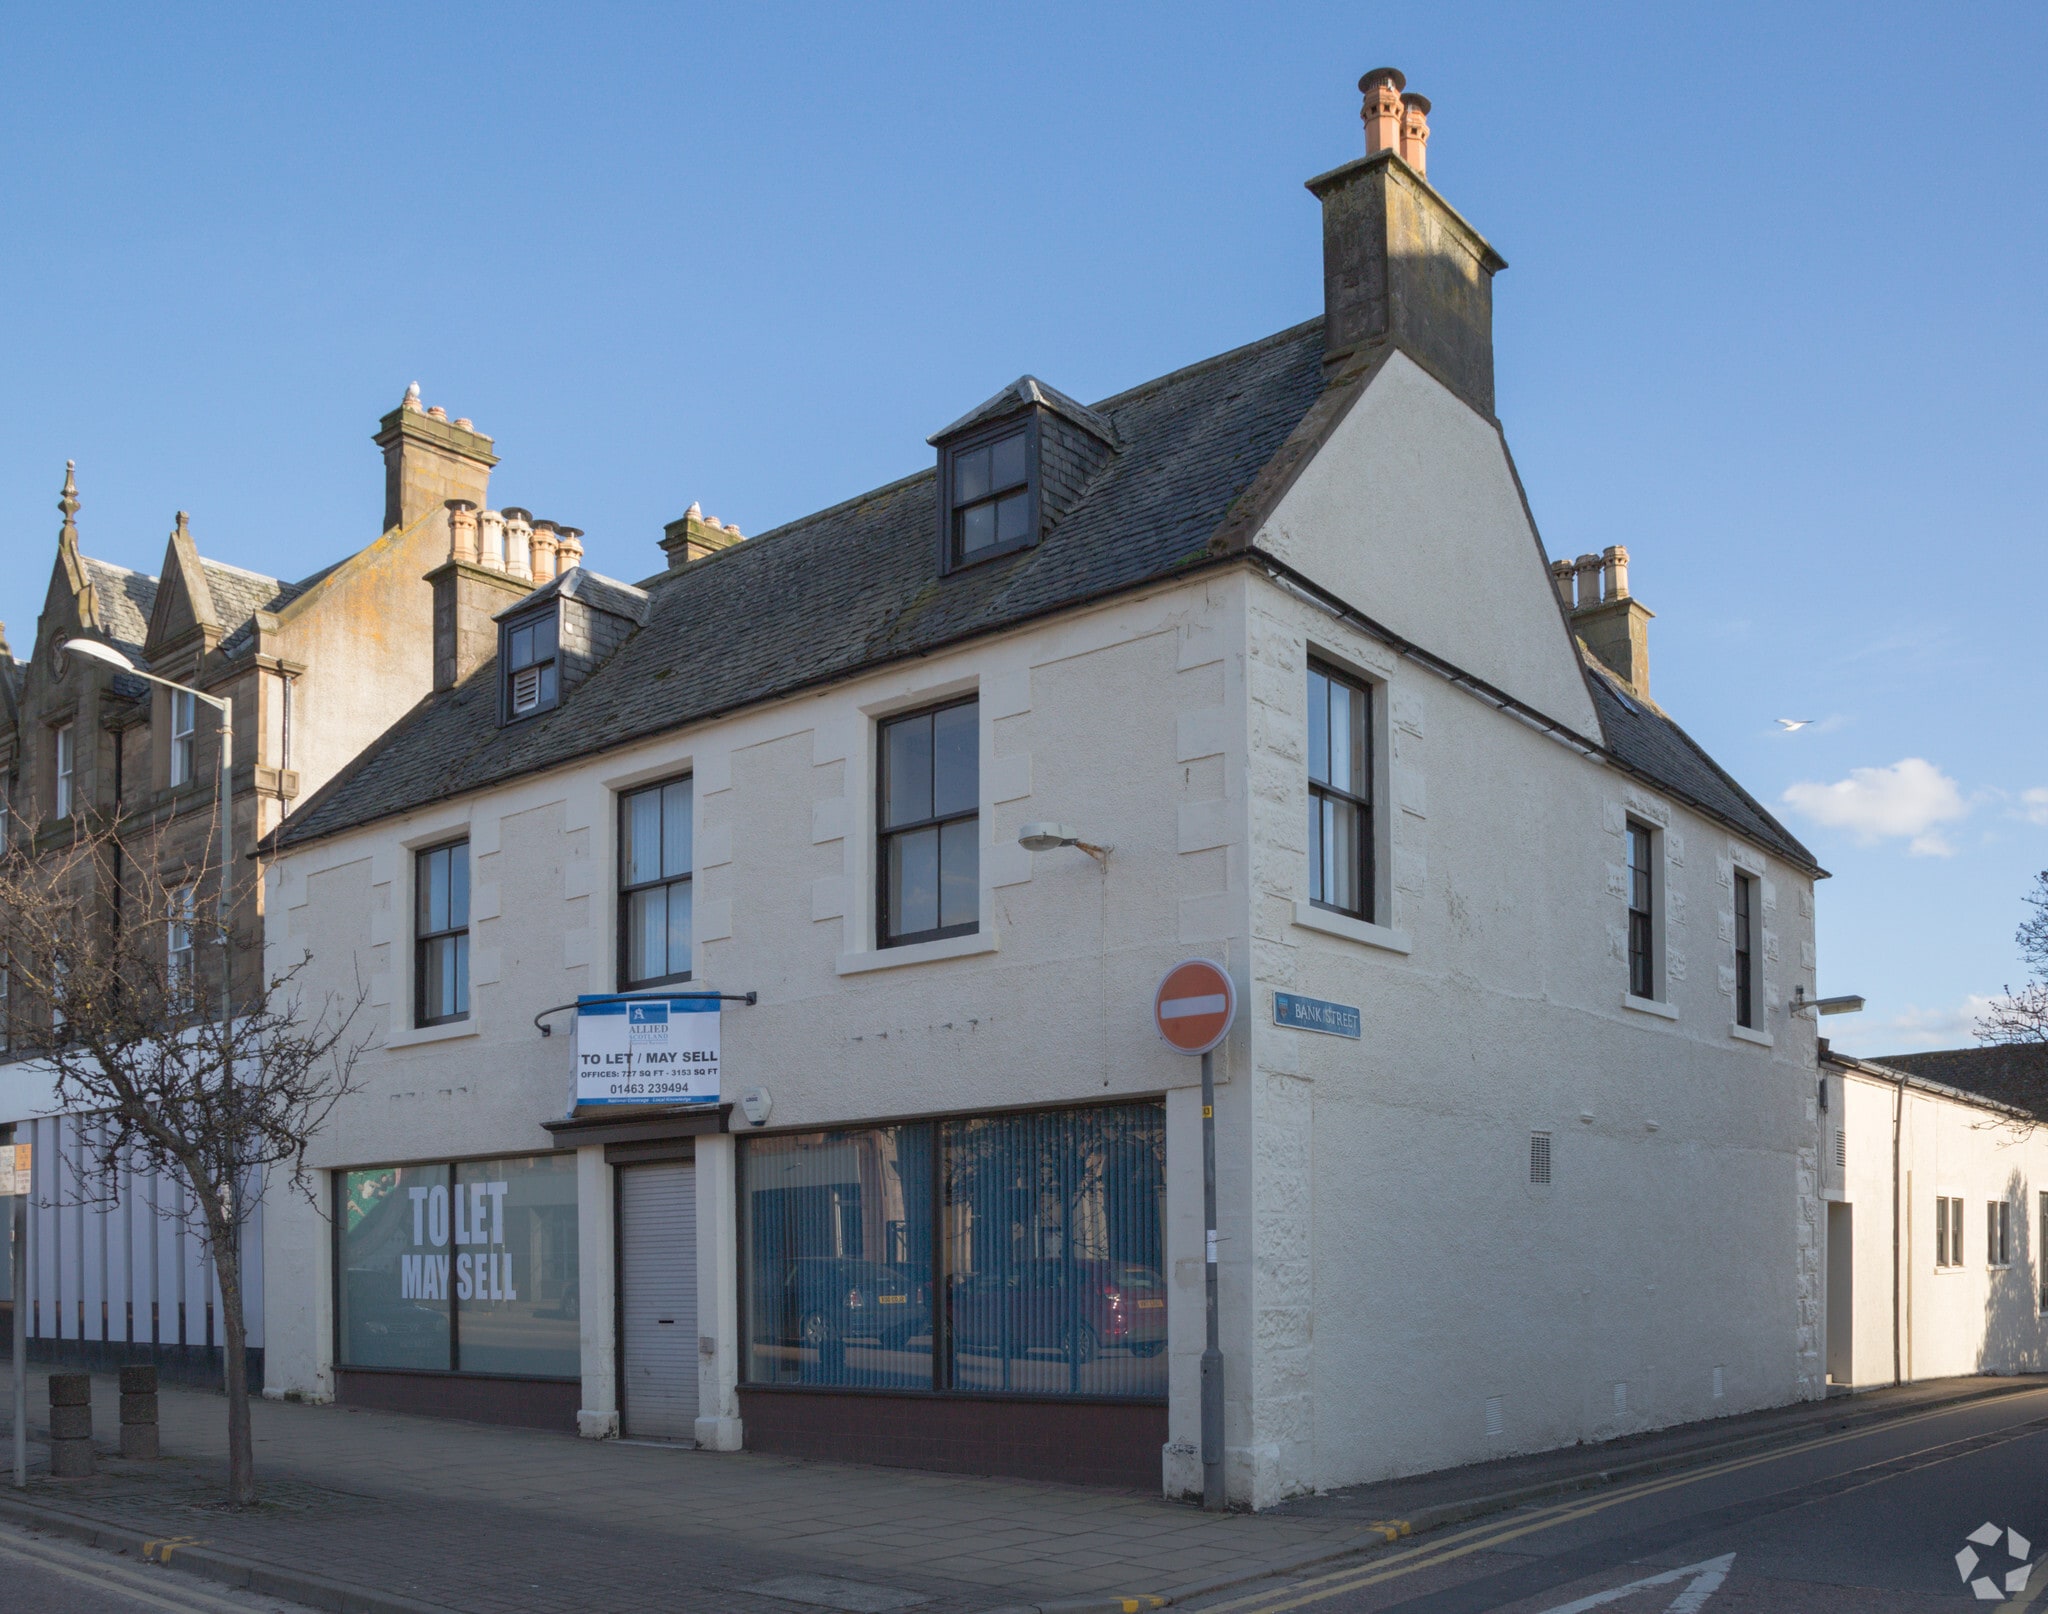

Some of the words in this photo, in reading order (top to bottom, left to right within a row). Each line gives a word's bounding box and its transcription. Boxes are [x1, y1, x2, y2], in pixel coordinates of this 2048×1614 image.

[1295, 1003, 1322, 1023] BANK
[1325, 1009, 1358, 1030] STREET
[629, 1024, 669, 1034] ALLIED
[629, 1033, 669, 1041] SCOTLAND
[581, 1054, 601, 1065] TO
[605, 1053, 633, 1065] LET
[637, 1052, 642, 1064] /
[646, 1052, 678, 1064] MAY
[682, 1050, 718, 1063] SELL
[581, 1071, 620, 1079] OFFICES:
[639, 1070, 651, 1078] SQ
[653, 1069, 664, 1077] FT
[671, 1069, 692, 1077] 3153
[694, 1068, 706, 1076] SQ
[707, 1068, 718, 1076] FT
[610, 1083, 645, 1094] 01463
[648, 1082, 689, 1093] 239494
[408, 1184, 449, 1247] TO
[454, 1181, 508, 1246] LET
[401, 1254, 450, 1301] MAY
[456, 1252, 517, 1302] SELL
